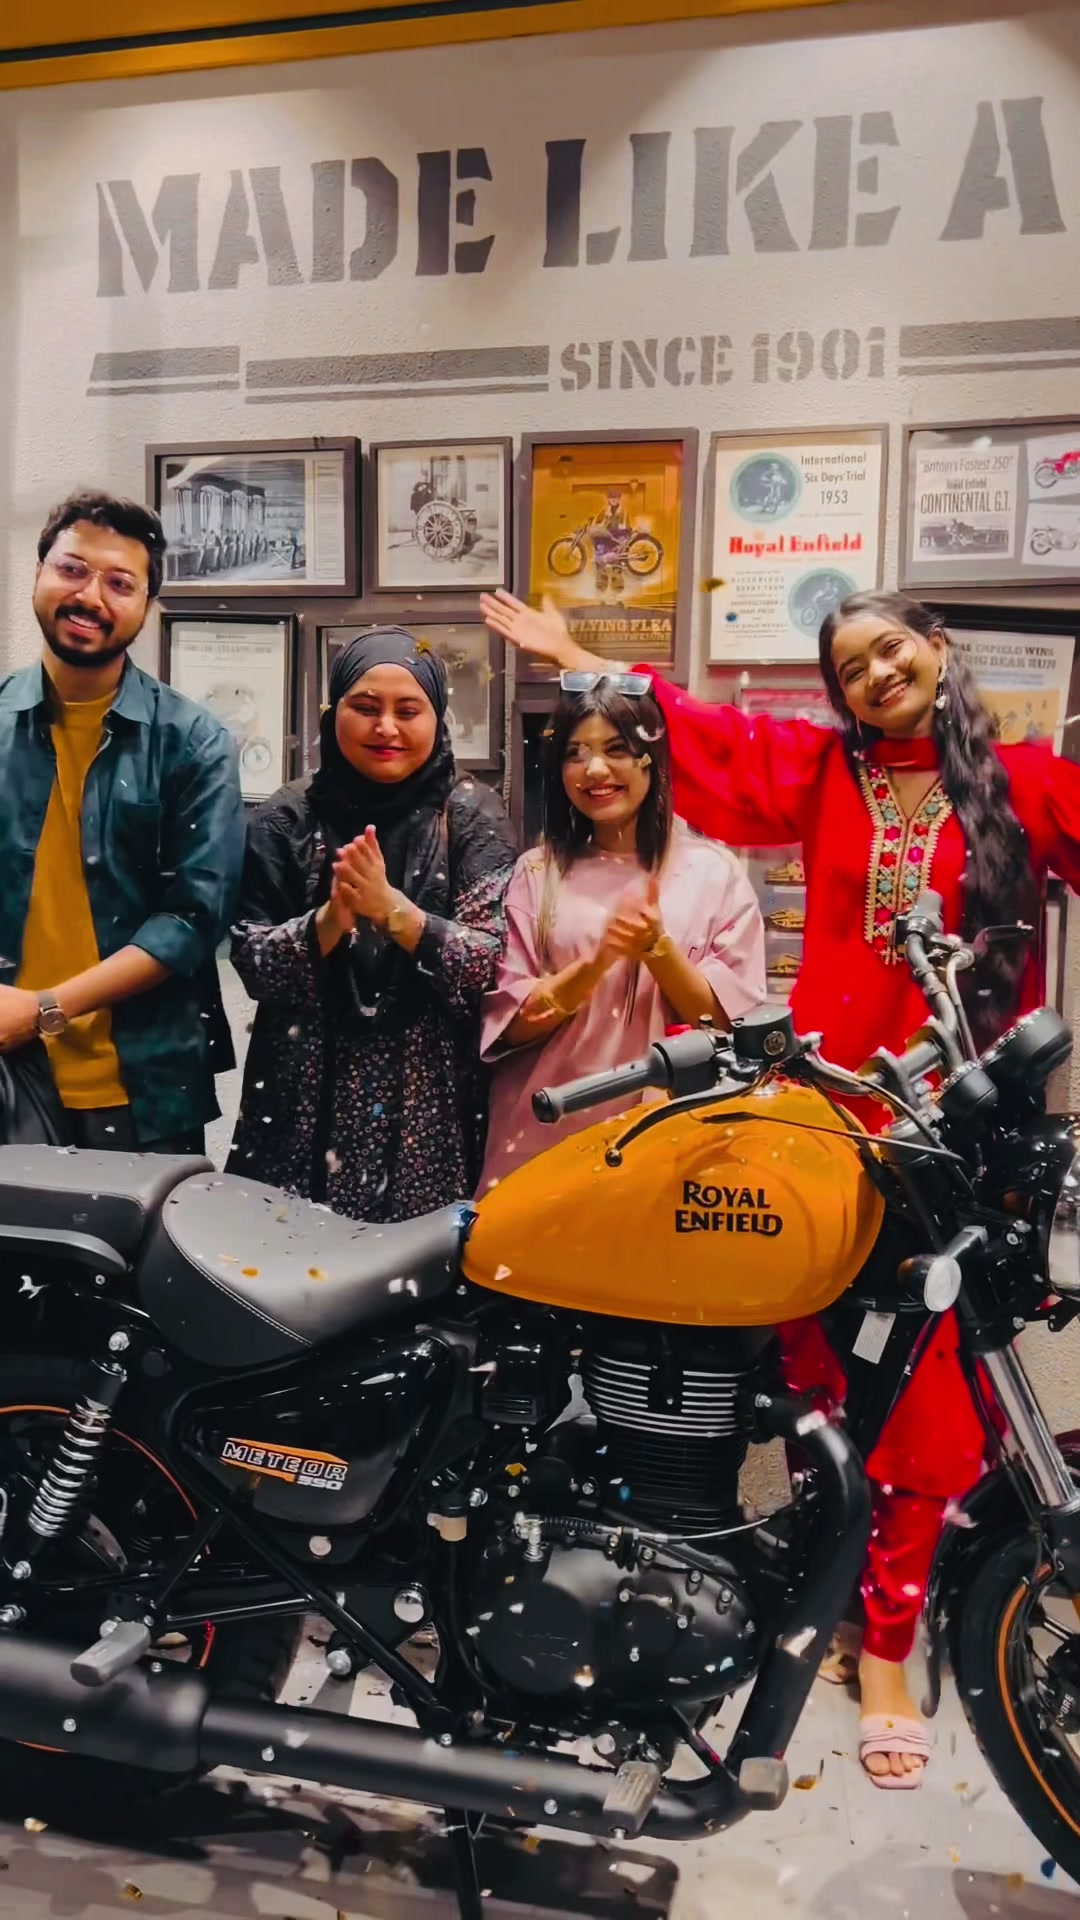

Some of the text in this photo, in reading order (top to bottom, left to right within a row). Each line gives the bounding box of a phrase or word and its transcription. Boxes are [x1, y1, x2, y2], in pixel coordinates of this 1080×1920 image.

[96, 96, 1066, 298] MADE LIKE A
[560, 326, 886, 392] SINCE 1901
[801, 452, 867, 466] International
[805, 469, 866, 485] Six Days Trial
[821, 489, 849, 505] 1953
[920, 491, 991, 515] CONTINENTAL
[729, 531, 863, 558] Royal Enfield
[569, 618, 673, 633] FLYING FLEA
[682, 1180, 771, 1209] ROYAL
[675, 1209, 783, 1237] ENFIELD
[222, 1441, 348, 1481] METEOR
